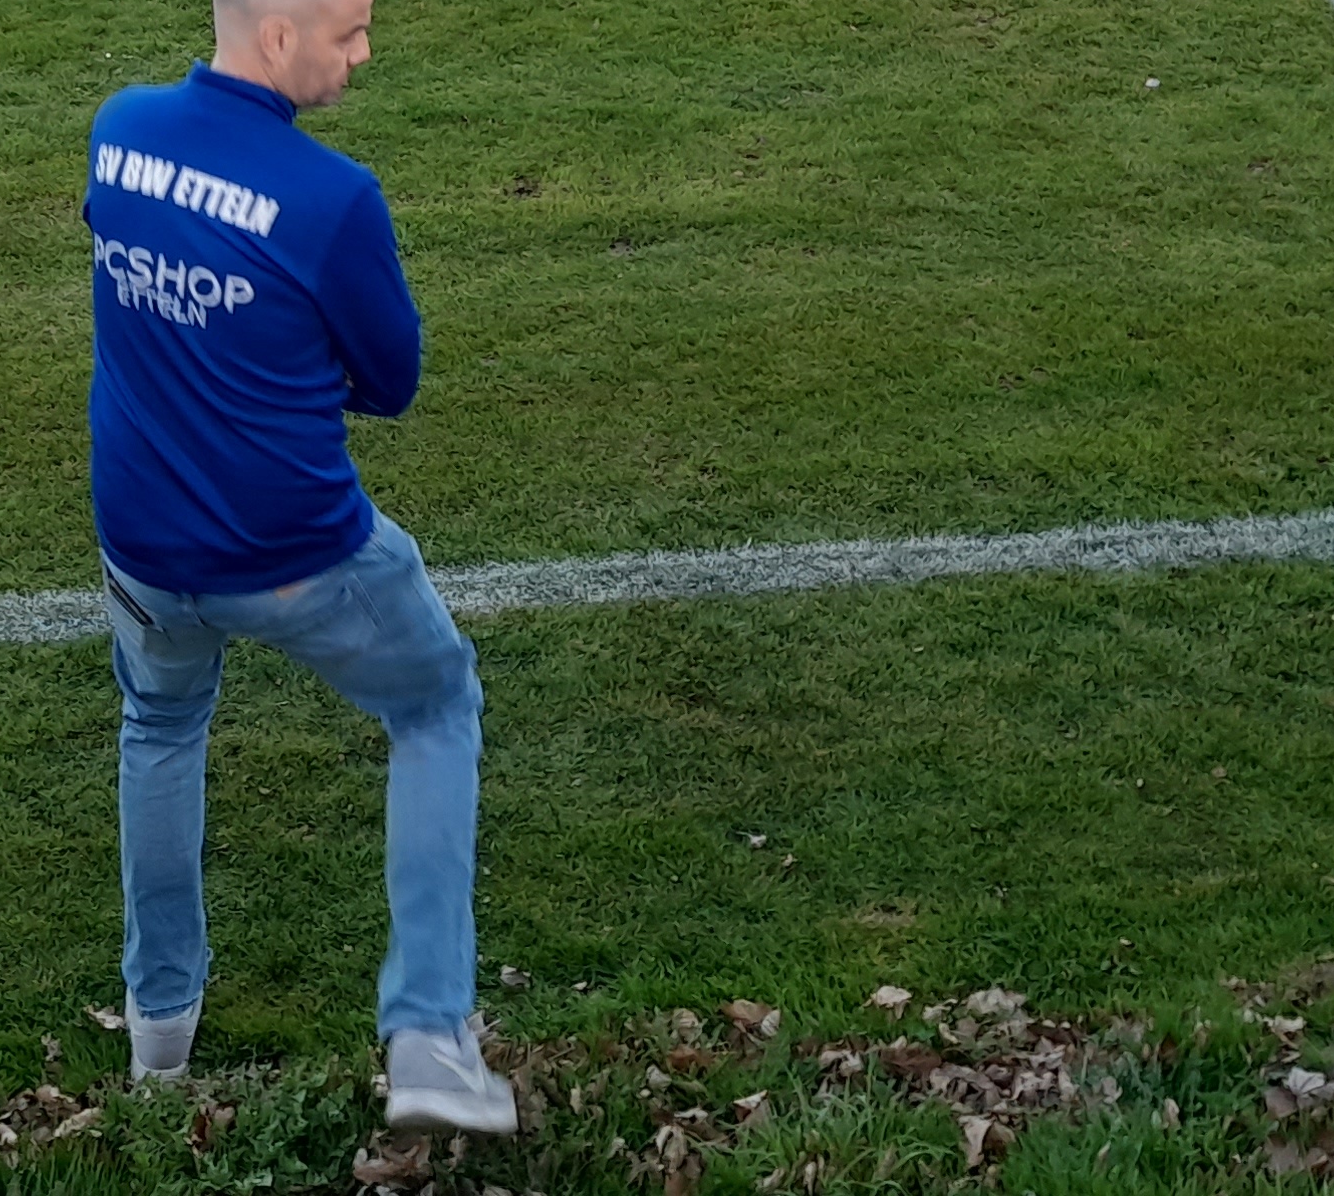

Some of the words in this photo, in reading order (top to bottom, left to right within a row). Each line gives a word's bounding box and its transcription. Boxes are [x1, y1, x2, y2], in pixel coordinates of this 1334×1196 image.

[94, 142, 123, 187] SV
[120, 149, 176, 202] BW
[172, 164, 281, 238] ETTELN
[94, 232, 255, 314] PCSHOP
[116, 278, 207, 329] ETTELN
